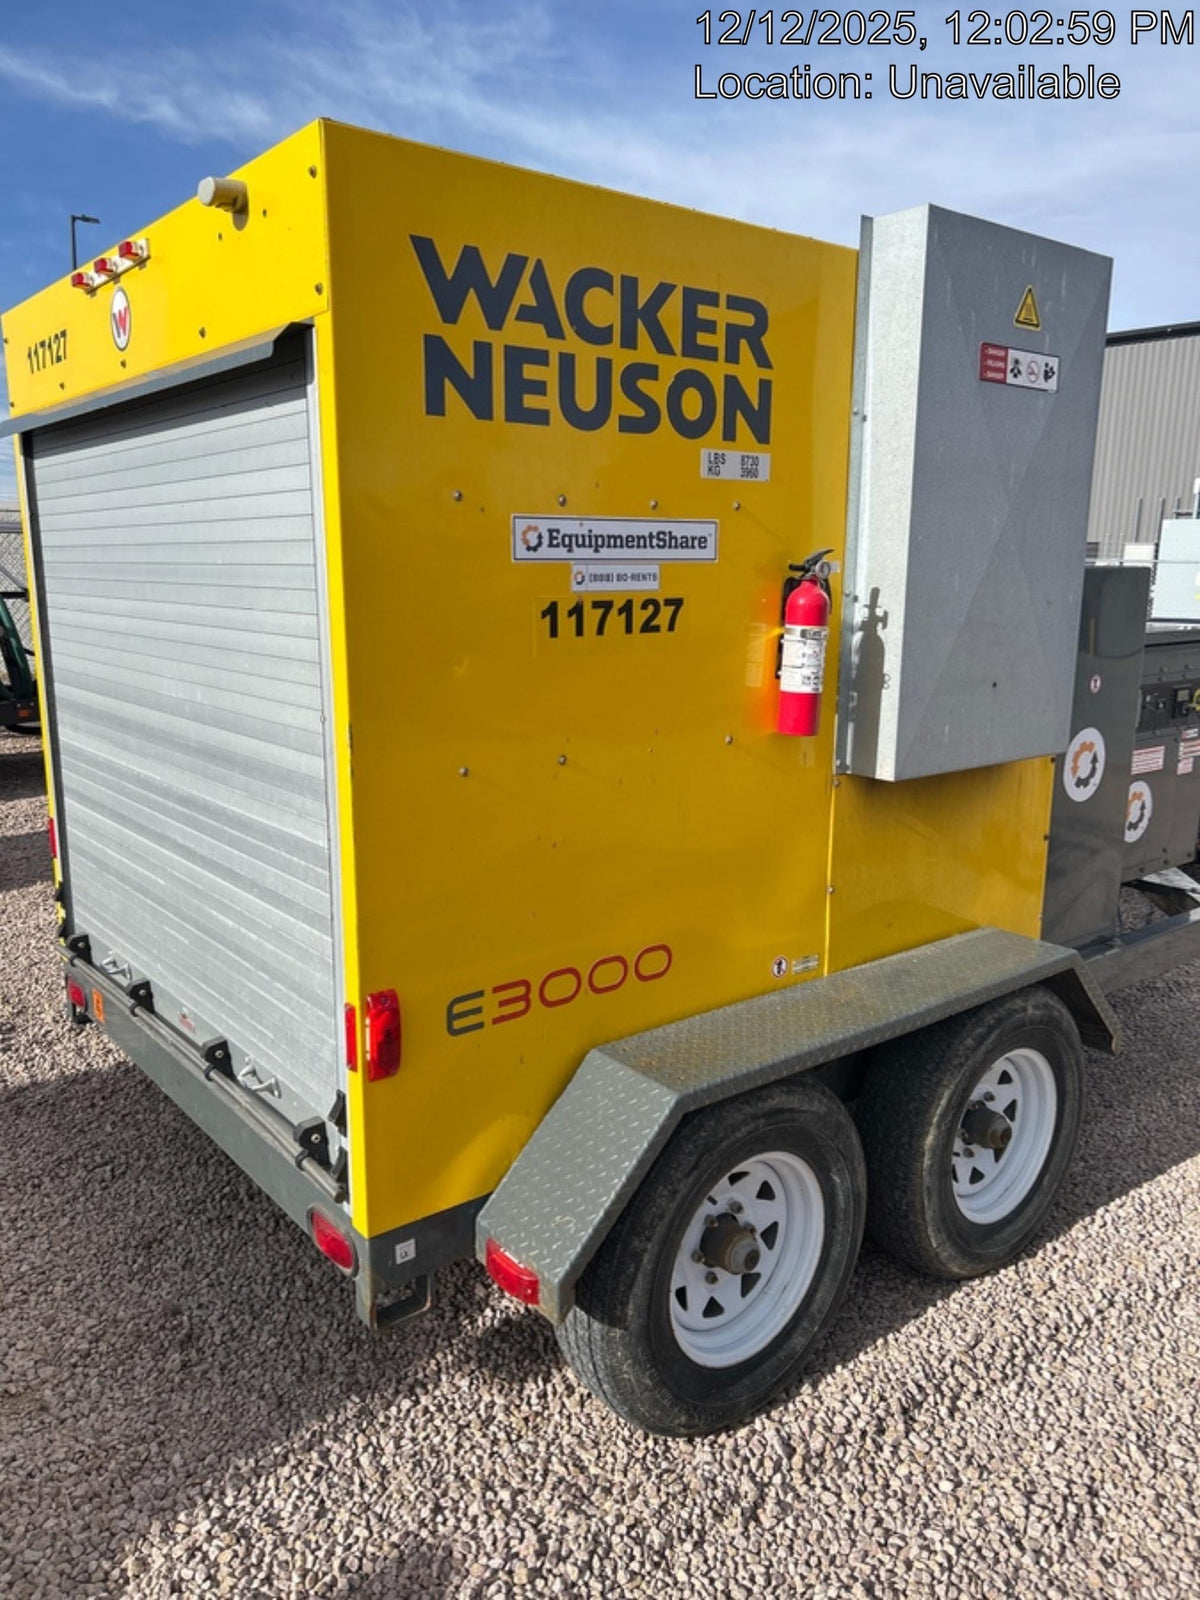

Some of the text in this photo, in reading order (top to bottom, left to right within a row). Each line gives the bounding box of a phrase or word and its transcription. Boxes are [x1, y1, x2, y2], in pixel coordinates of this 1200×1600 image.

[409, 234, 774, 370] WACKER
[27, 329, 67, 374] 117127
[424, 334, 773, 445] NEUSON
[707, 452, 726, 465] LBS
[707, 465, 721, 476] KG
[547, 529, 708, 552] EquipmentShare
[541, 597, 684, 638] 117127
[446, 944, 673, 1037] E3000
